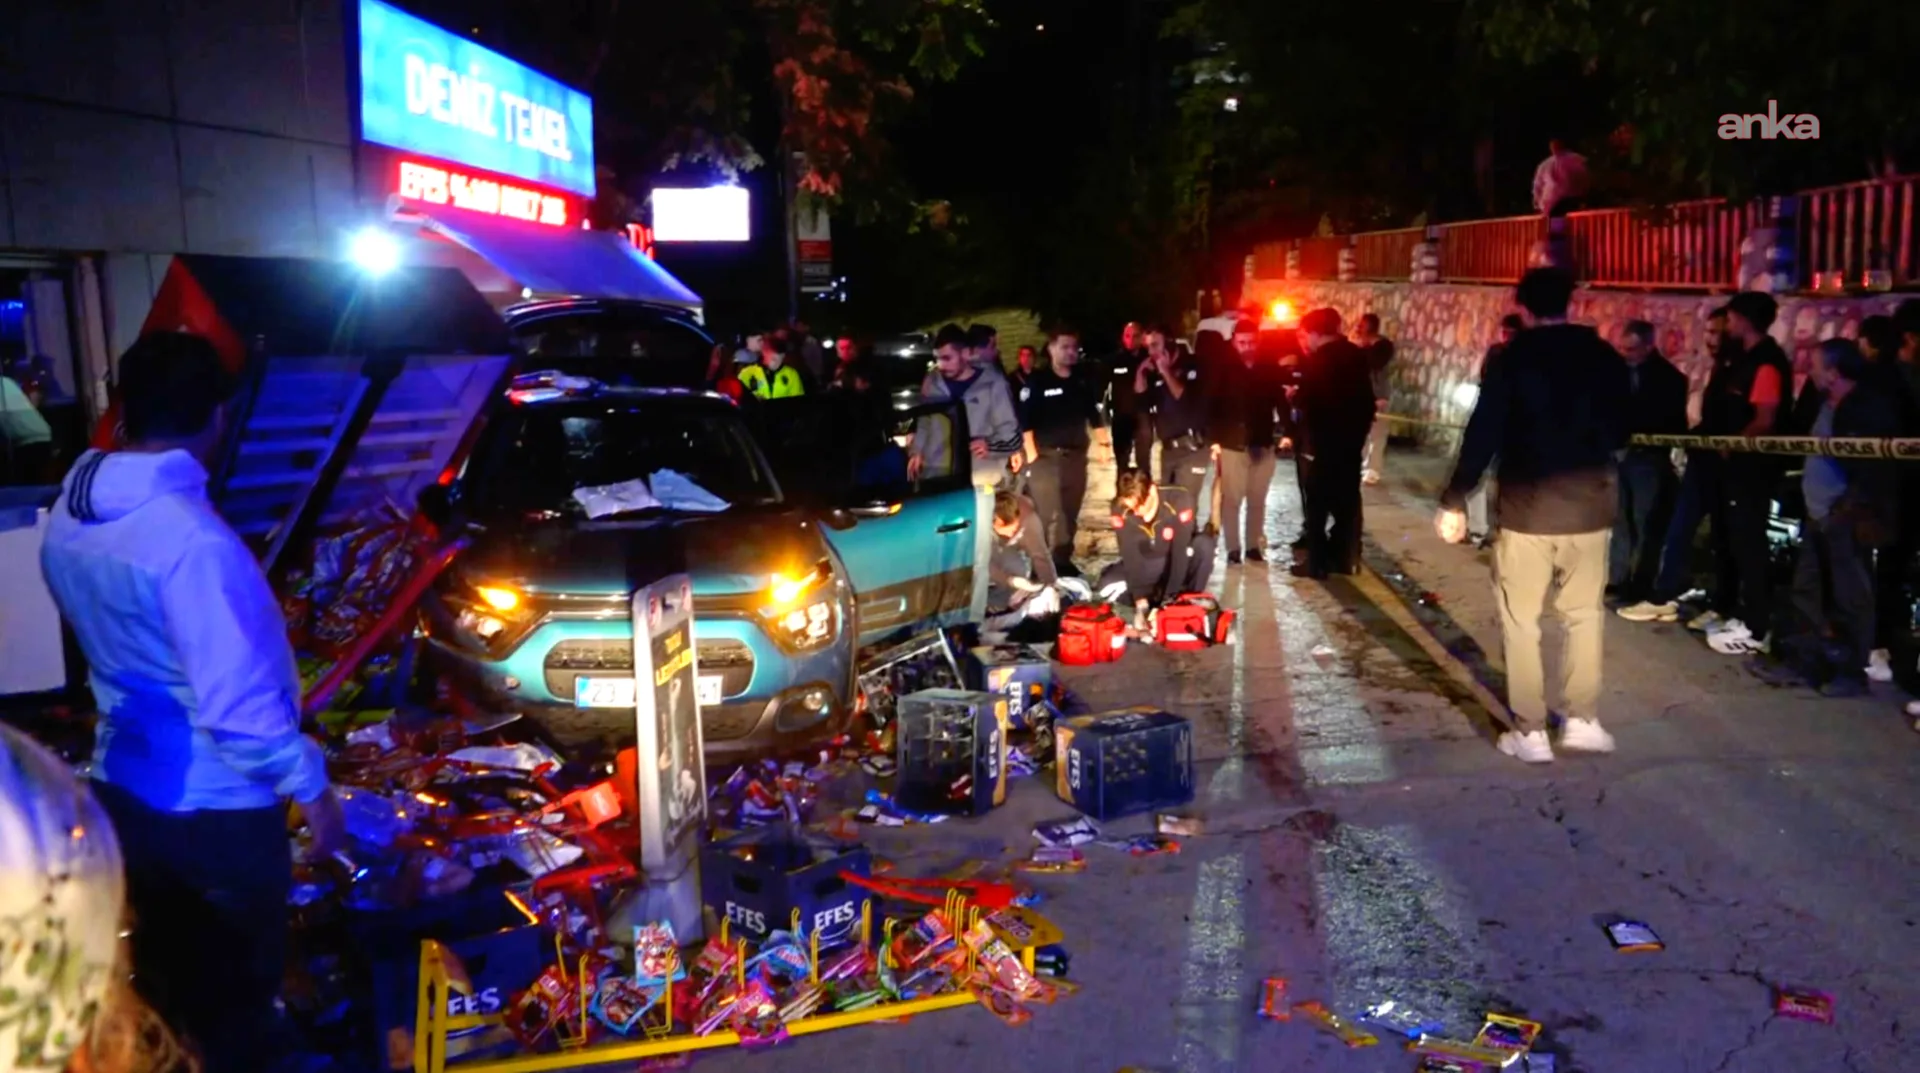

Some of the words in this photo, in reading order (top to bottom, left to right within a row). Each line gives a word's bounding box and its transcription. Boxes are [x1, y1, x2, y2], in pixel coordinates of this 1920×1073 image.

[405, 53, 498, 138] DENİZ
[500, 90, 573, 163] TEKEL
[400, 161, 448, 204] EFES
[1009, 681, 1022, 715] EFES
[989, 730, 999, 779] EFES
[1069, 747, 1080, 790] EFES
[726, 901, 767, 934] EFES
[814, 900, 855, 931] EFES
[434, 986, 502, 1017] FES
